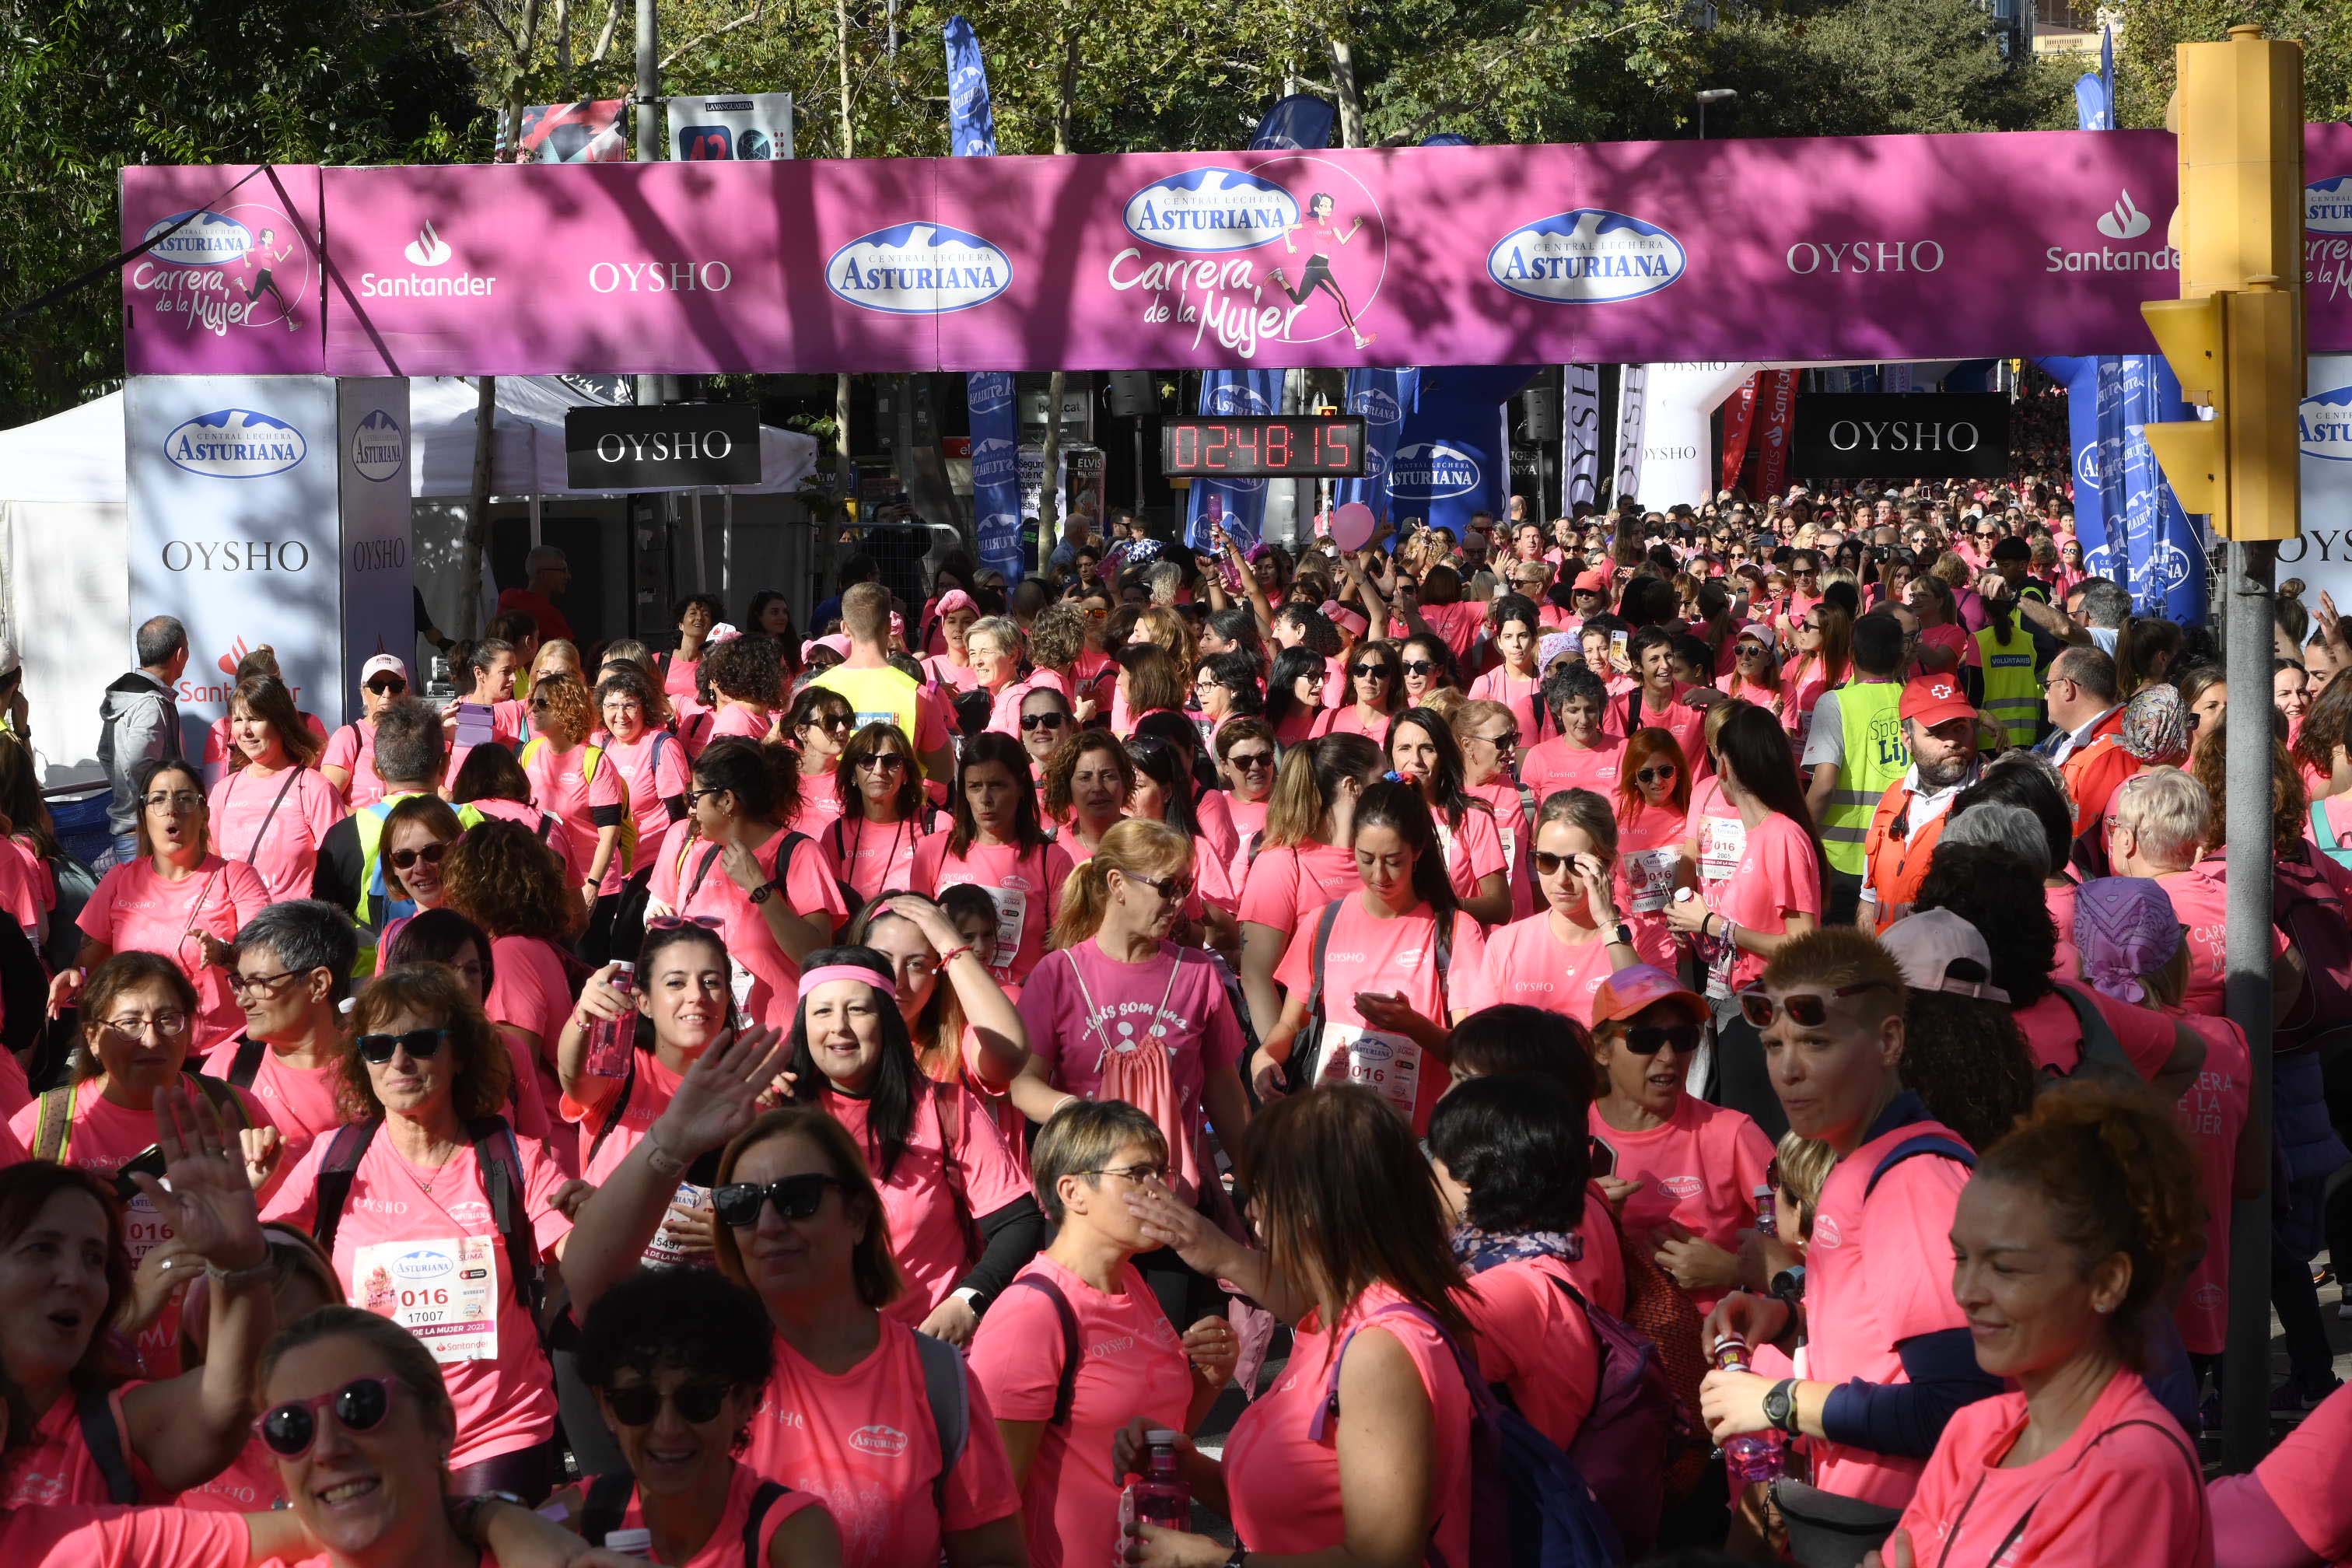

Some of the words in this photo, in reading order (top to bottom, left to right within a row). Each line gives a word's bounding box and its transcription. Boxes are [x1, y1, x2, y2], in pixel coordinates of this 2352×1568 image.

[1164, 196, 1220, 206] CENTRAL
[1225, 194, 1282, 205] LECHERA
[1136, 199, 1285, 230] ASTURIANA
[1534, 241, 1595, 251] CENTRAL
[1600, 240, 1664, 250] LECHERA
[869, 254, 928, 262] CENTRAL
[933, 253, 992, 261] LECHERA
[1503, 245, 1671, 280] ASTURIANA
[1787, 240, 1944, 275] OYSHO
[2046, 245, 2181, 272] Santande
[133, 261, 224, 291] Carrera
[589, 261, 732, 293] OYSHO
[840, 256, 997, 291] ASTURIANA
[1108, 248, 1253, 292] Carrera
[2318, 261, 2333, 283] la
[361, 272, 496, 298] Santander
[156, 292, 173, 312] de
[177, 292, 188, 312] la
[186, 288, 260, 337] Mujer
[1144, 295, 1171, 324] de
[1176, 290, 1196, 323] la
[1192, 285, 1309, 359] Mujer
[175, 434, 296, 460] ASTURIANA
[597, 429, 732, 463] OYSHO
[1175, 425, 1349, 467] 02:48:15
[1829, 420, 1979, 452] OYSHO
[356, 436, 401, 464] ASTURIANA
[1077, 458, 1101, 468] ELVIS
[1388, 470, 1473, 487] ASTURIANA
[162, 540, 309, 572] OYSHO
[354, 537, 405, 572] OYSHO
[1991, 656, 2031, 665] VOLUNTARIS
[1714, 841, 1735, 852] 016
[1649, 870, 1671, 881] 016
[118, 898, 156, 909] OYSHO
[1327, 952, 1365, 963] OYSHO
[1515, 981, 1555, 992] OYSHO
[1119, 1002, 1154, 1017] som
[1353, 1066, 1384, 1082] 016
[352, 1197, 408, 1214] OYSHO
[130, 1223, 175, 1240] 016
[397, 1262, 449, 1273] ASTURIANA
[401, 1288, 449, 1307] 016
[408, 1311, 444, 1323] 17007
[436, 1325, 464, 1334] MUJER
[1092, 1335, 1134, 1358] OYSHO
